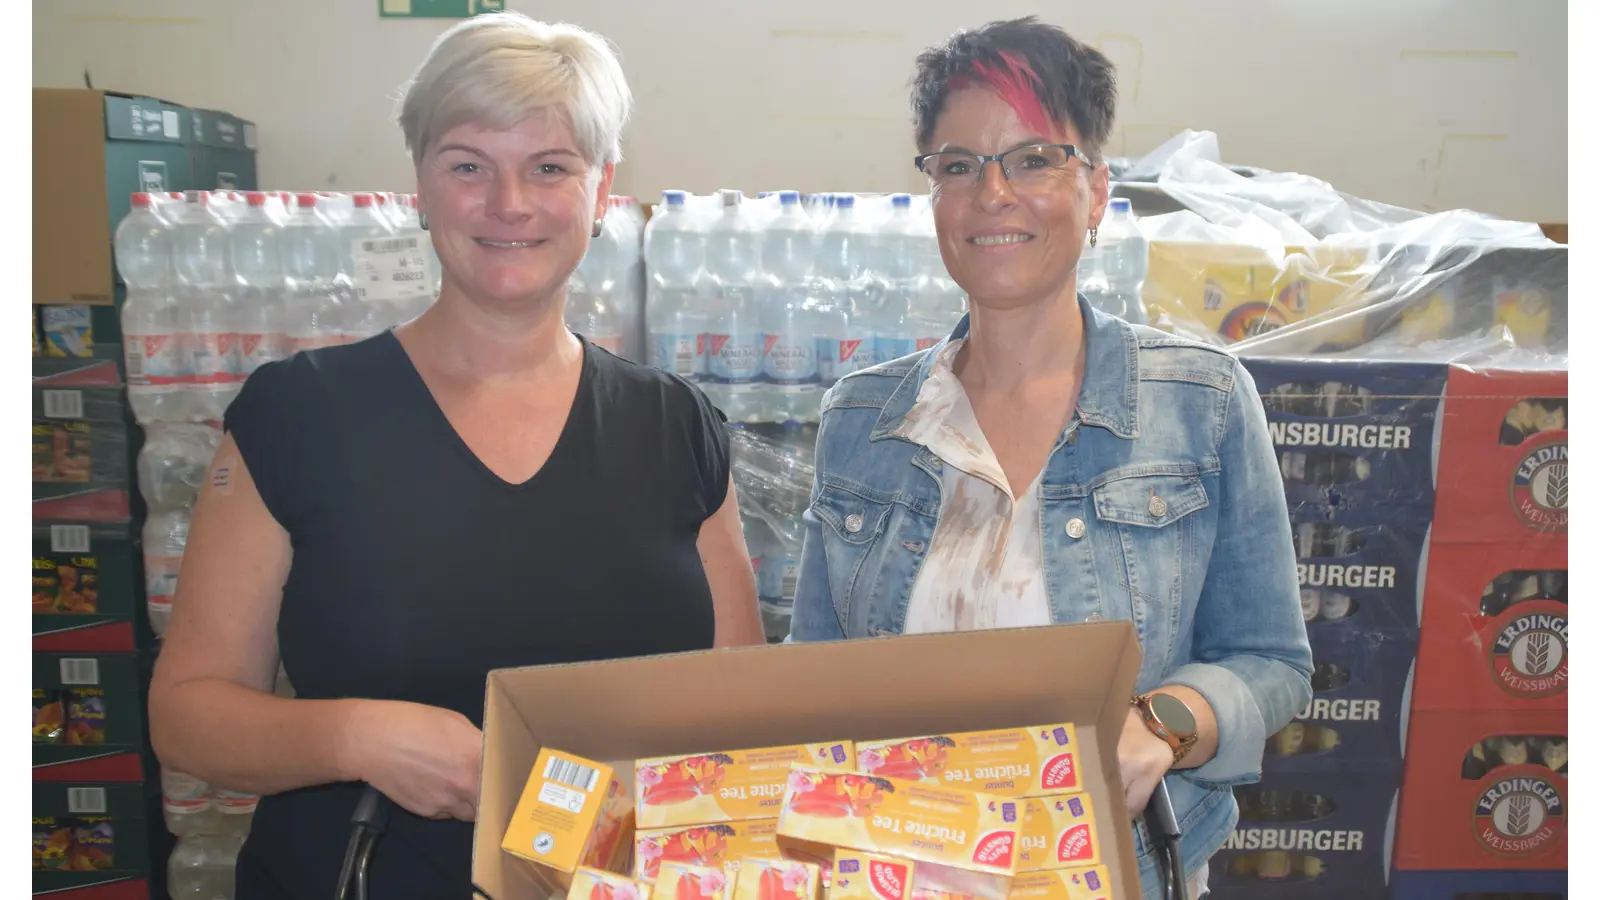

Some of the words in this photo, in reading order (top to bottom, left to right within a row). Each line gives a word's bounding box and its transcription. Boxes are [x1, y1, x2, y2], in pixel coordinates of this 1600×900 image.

[1297, 564, 1396, 588] BURGER
[944, 768, 973, 782] Tee
[976, 764, 1030, 780] Früchte
[720, 784, 748, 800] Tee
[1480, 778, 1560, 811] ERDINGER
[872, 814, 901, 834] Tee
[904, 820, 966, 845] Früchte
